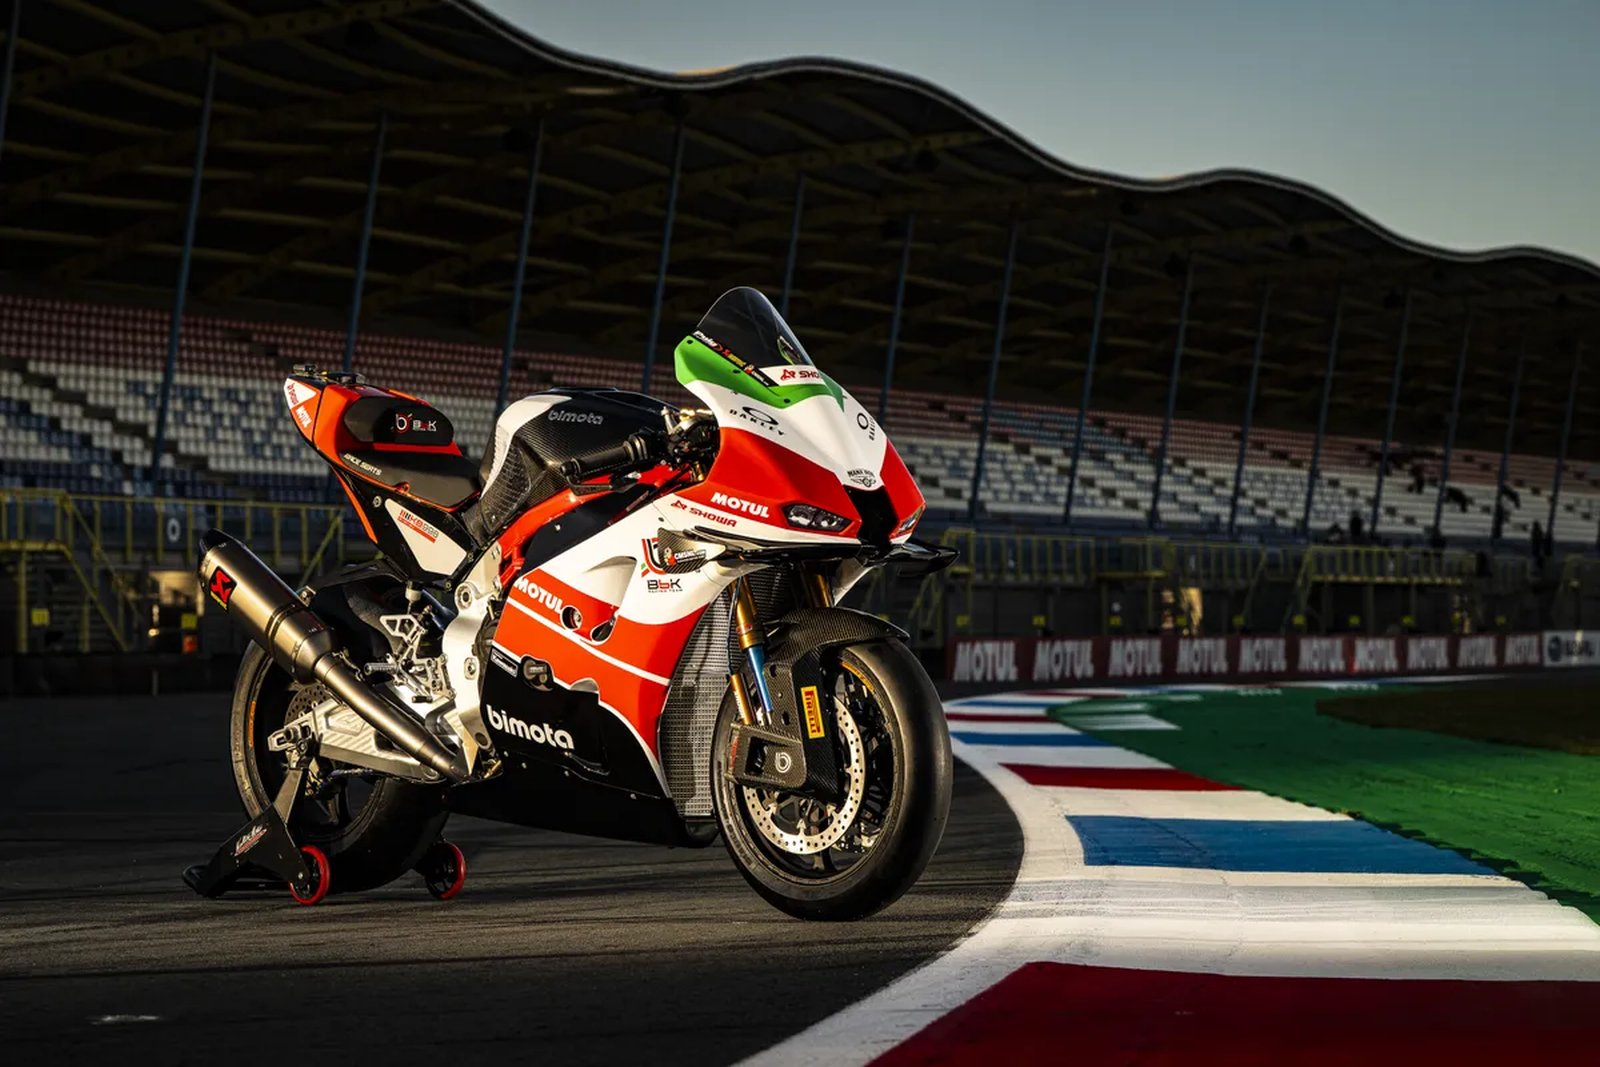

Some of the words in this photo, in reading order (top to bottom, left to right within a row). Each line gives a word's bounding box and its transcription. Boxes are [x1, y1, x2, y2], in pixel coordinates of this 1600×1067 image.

[548, 410, 604, 425] bimota
[689, 507, 737, 527] SHOWA
[710, 492, 769, 518] MOTUL
[513, 577, 563, 614] MOTUL
[953, 641, 1018, 682] MOTUL
[1032, 640, 1094, 681] MOTUL
[1107, 638, 1163, 677] MOTUL
[1176, 637, 1228, 674] MOTUL
[1237, 637, 1287, 673] MOTUL
[486, 704, 575, 750] bimota
[804, 690, 820, 734] PIRELLI
